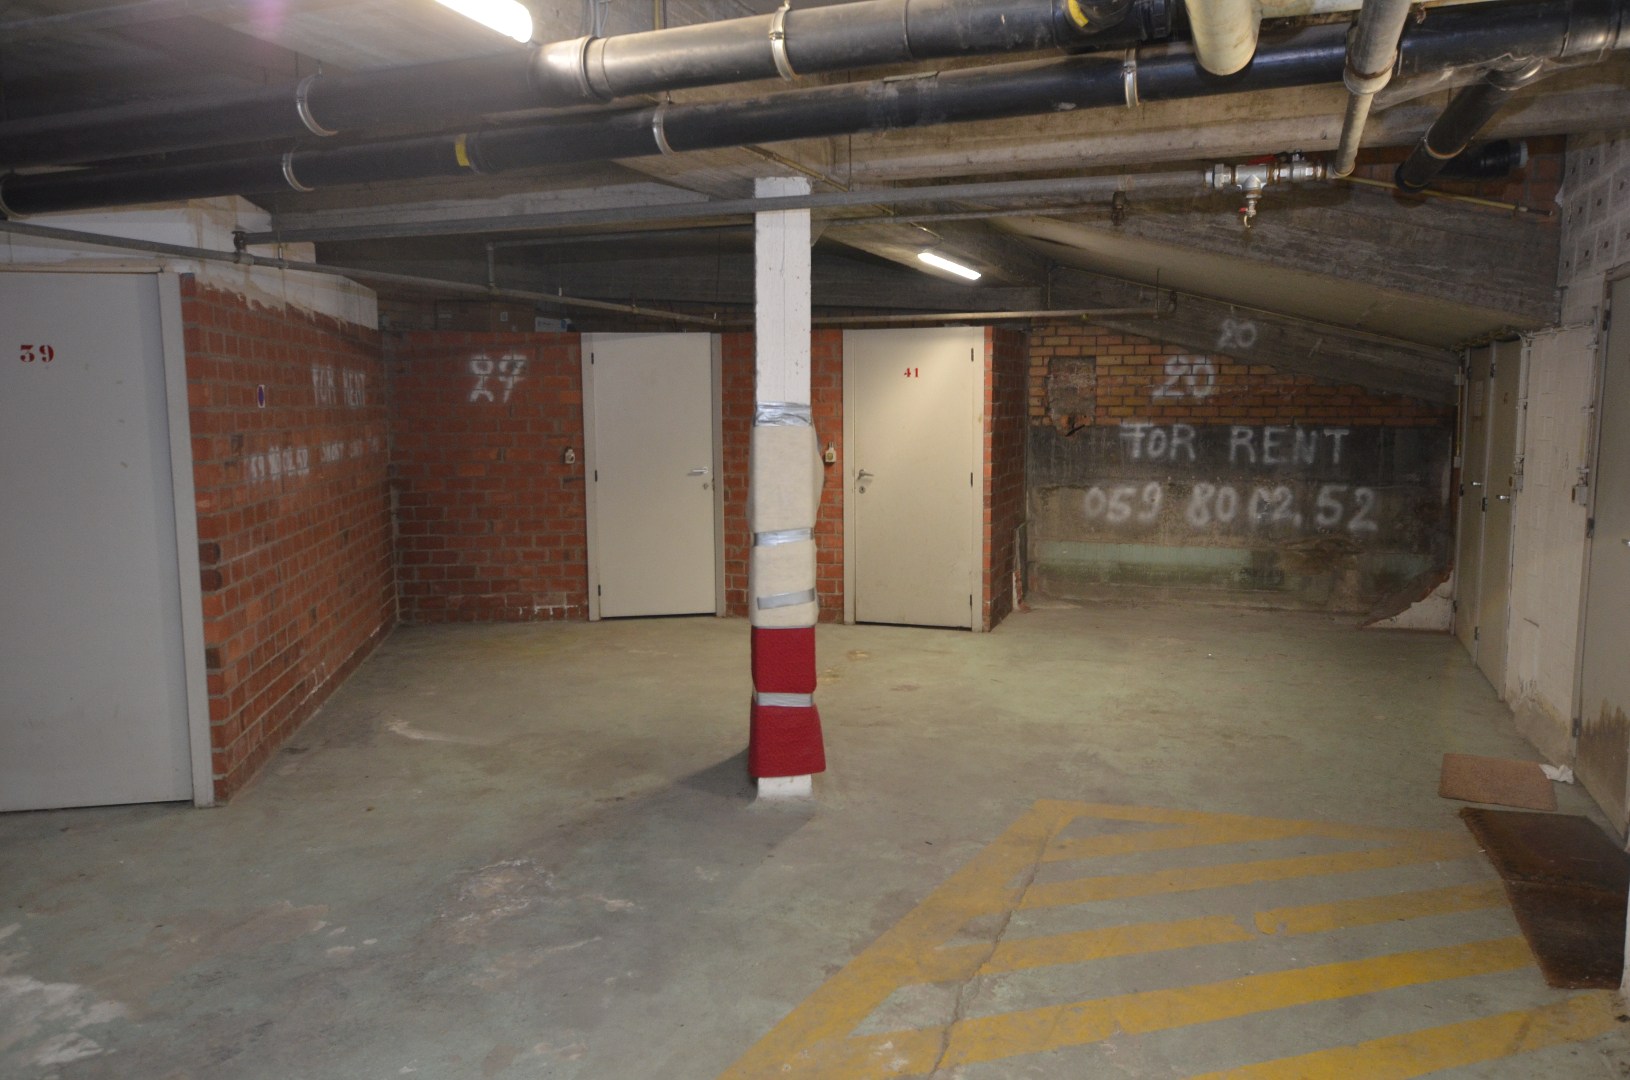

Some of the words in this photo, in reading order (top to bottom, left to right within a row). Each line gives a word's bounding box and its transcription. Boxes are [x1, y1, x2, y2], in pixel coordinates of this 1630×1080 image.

[20, 344, 54, 362] 39
[904, 368, 919, 377] 41
[1152, 354, 1216, 398] 20
[1230, 424, 1349, 464] RENT
[1083, 482, 1163, 522] 059
[1186, 484, 1239, 525] 80
